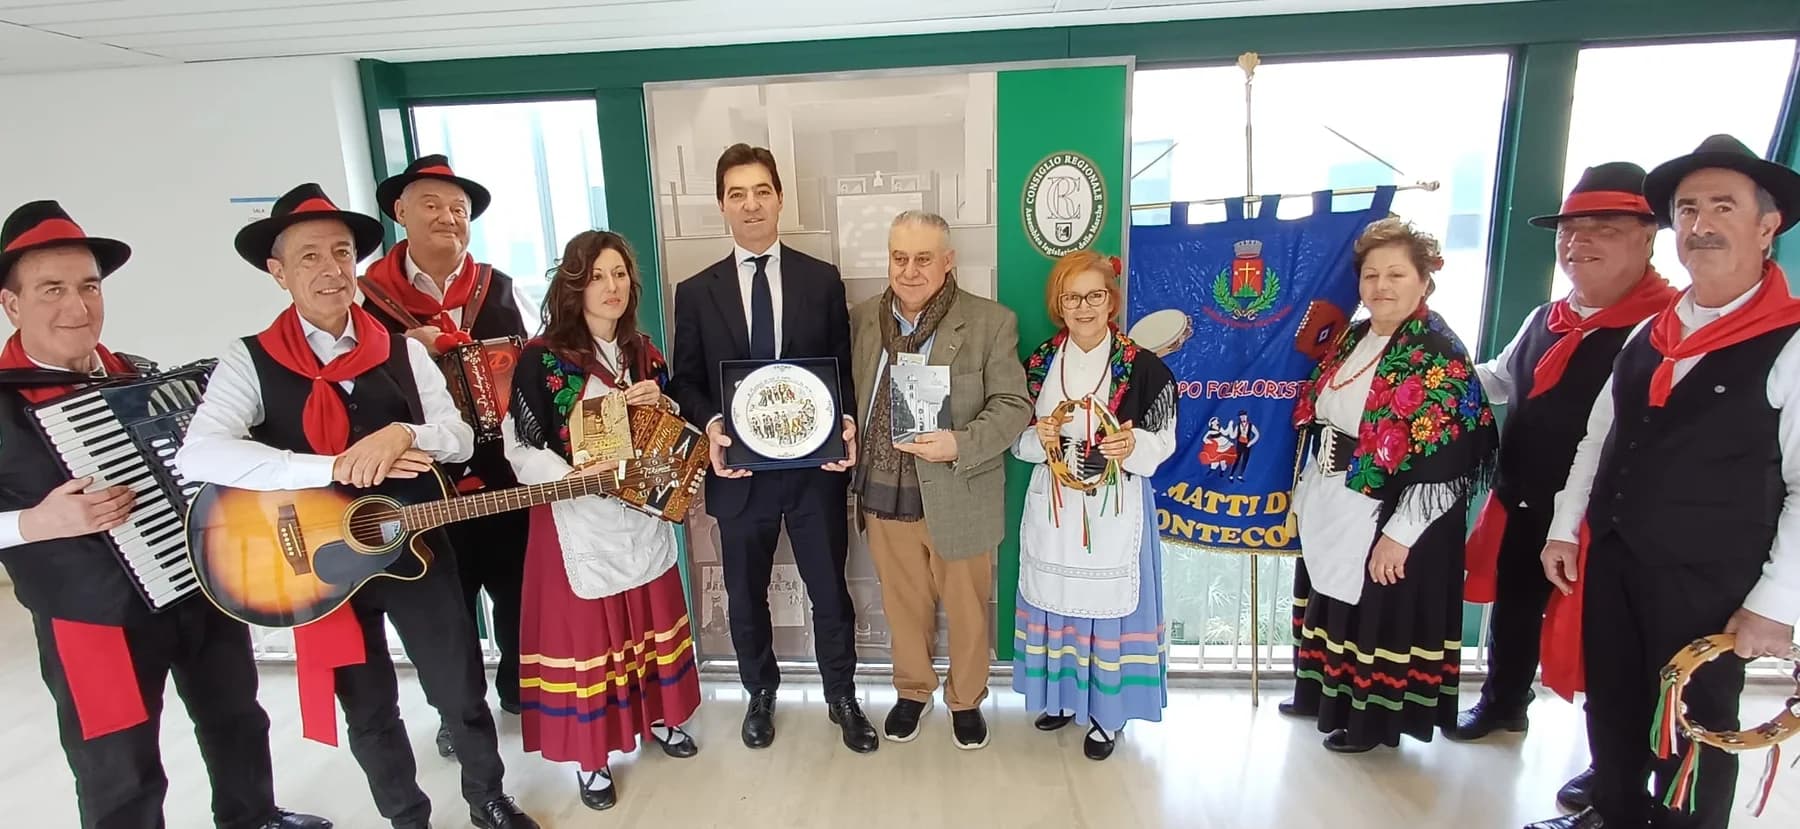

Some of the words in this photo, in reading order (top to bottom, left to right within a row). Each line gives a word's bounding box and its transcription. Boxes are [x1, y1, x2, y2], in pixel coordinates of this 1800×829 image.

[1026, 156, 1061, 205] CONSIGLIO
[1064, 155, 1103, 201] REGIONALE
[1177, 380, 1203, 399] PO
[1156, 508, 1290, 548] ONTECO
